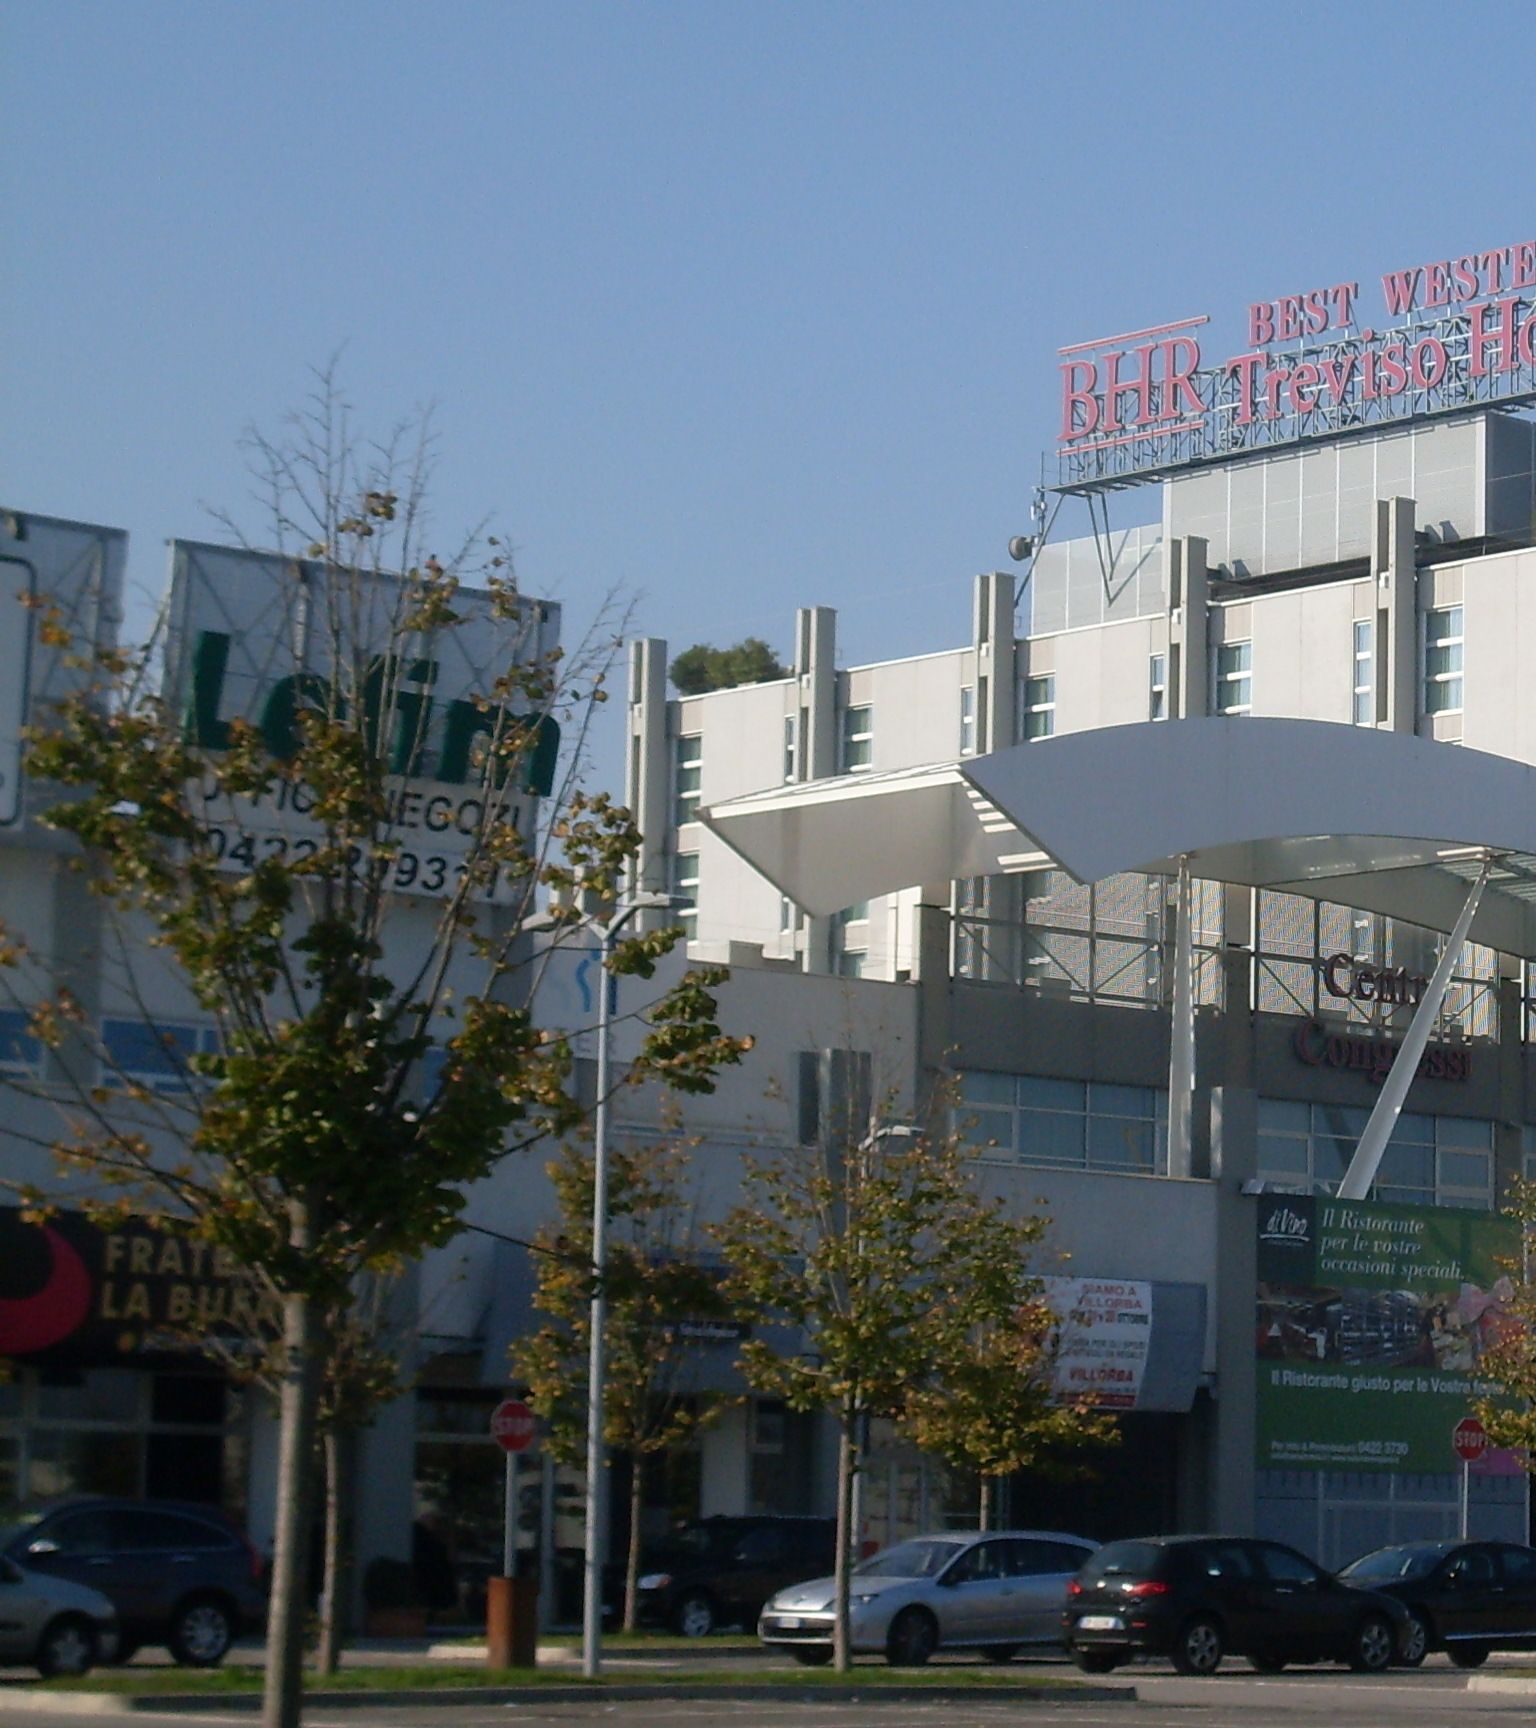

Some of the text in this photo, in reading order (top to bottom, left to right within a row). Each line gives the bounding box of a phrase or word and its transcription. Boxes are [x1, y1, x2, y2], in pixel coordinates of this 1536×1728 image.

[1248, 282, 1360, 346] BEST
[1056, 336, 1209, 442] BHR
[1225, 326, 1448, 426] Treviso
[1293, 1020, 1472, 1084] Congssi
[1341, 1210, 1425, 1236] Ristorante
[1320, 1238, 1347, 1256] per
[1353, 1234, 1368, 1251] le
[1374, 1238, 1421, 1256] vostre
[1321, 1256, 1465, 1284] occasioni speciali.
[99, 1281, 152, 1320] LA
[1283, 1370, 1349, 1389] Ristorante
[1351, 1374, 1391, 1392] giusto
[1393, 1377, 1415, 1394] per
[1455, 1431, 1484, 1447] STOP
